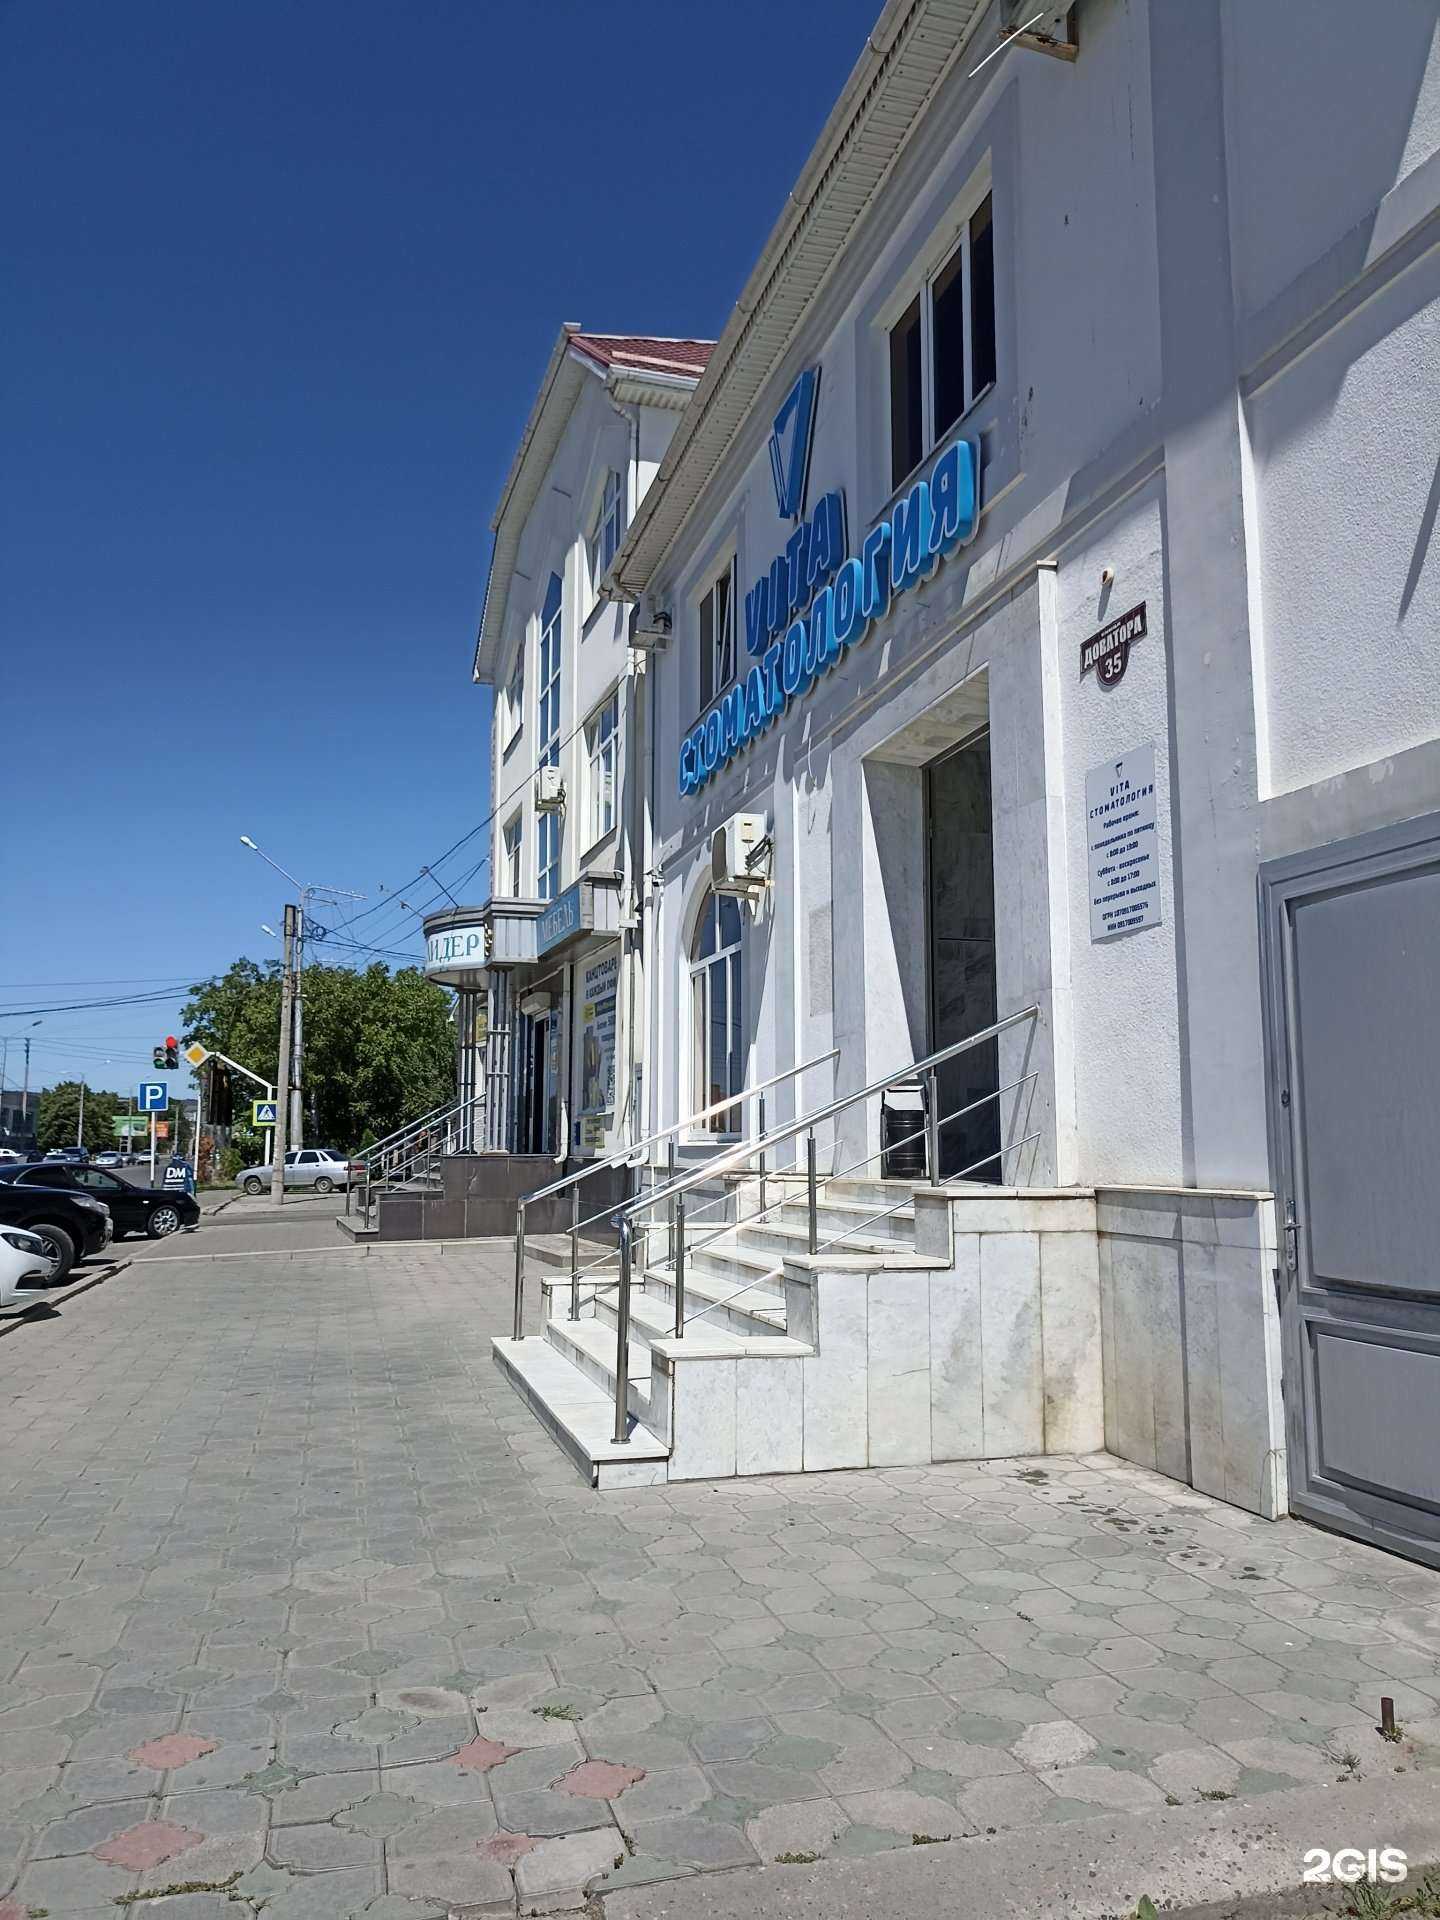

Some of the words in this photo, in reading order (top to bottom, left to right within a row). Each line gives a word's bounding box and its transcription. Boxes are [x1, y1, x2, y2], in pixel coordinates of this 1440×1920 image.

[745, 492, 844, 657] VITA
[679, 440, 977, 797] СТОМАТОЛОГИЯ
[1084, 614, 1142, 669] ДОВАТОРА
[1105, 651, 1122, 679] 35
[1090, 784, 1154, 818] СТОМАТОЛОГИЯ
[1110, 780, 1130, 797] VITA
[541, 900, 574, 942] МЕБЕЛЬ
[145, 1086, 163, 1109] P
[166, 1167, 186, 1178] DM
